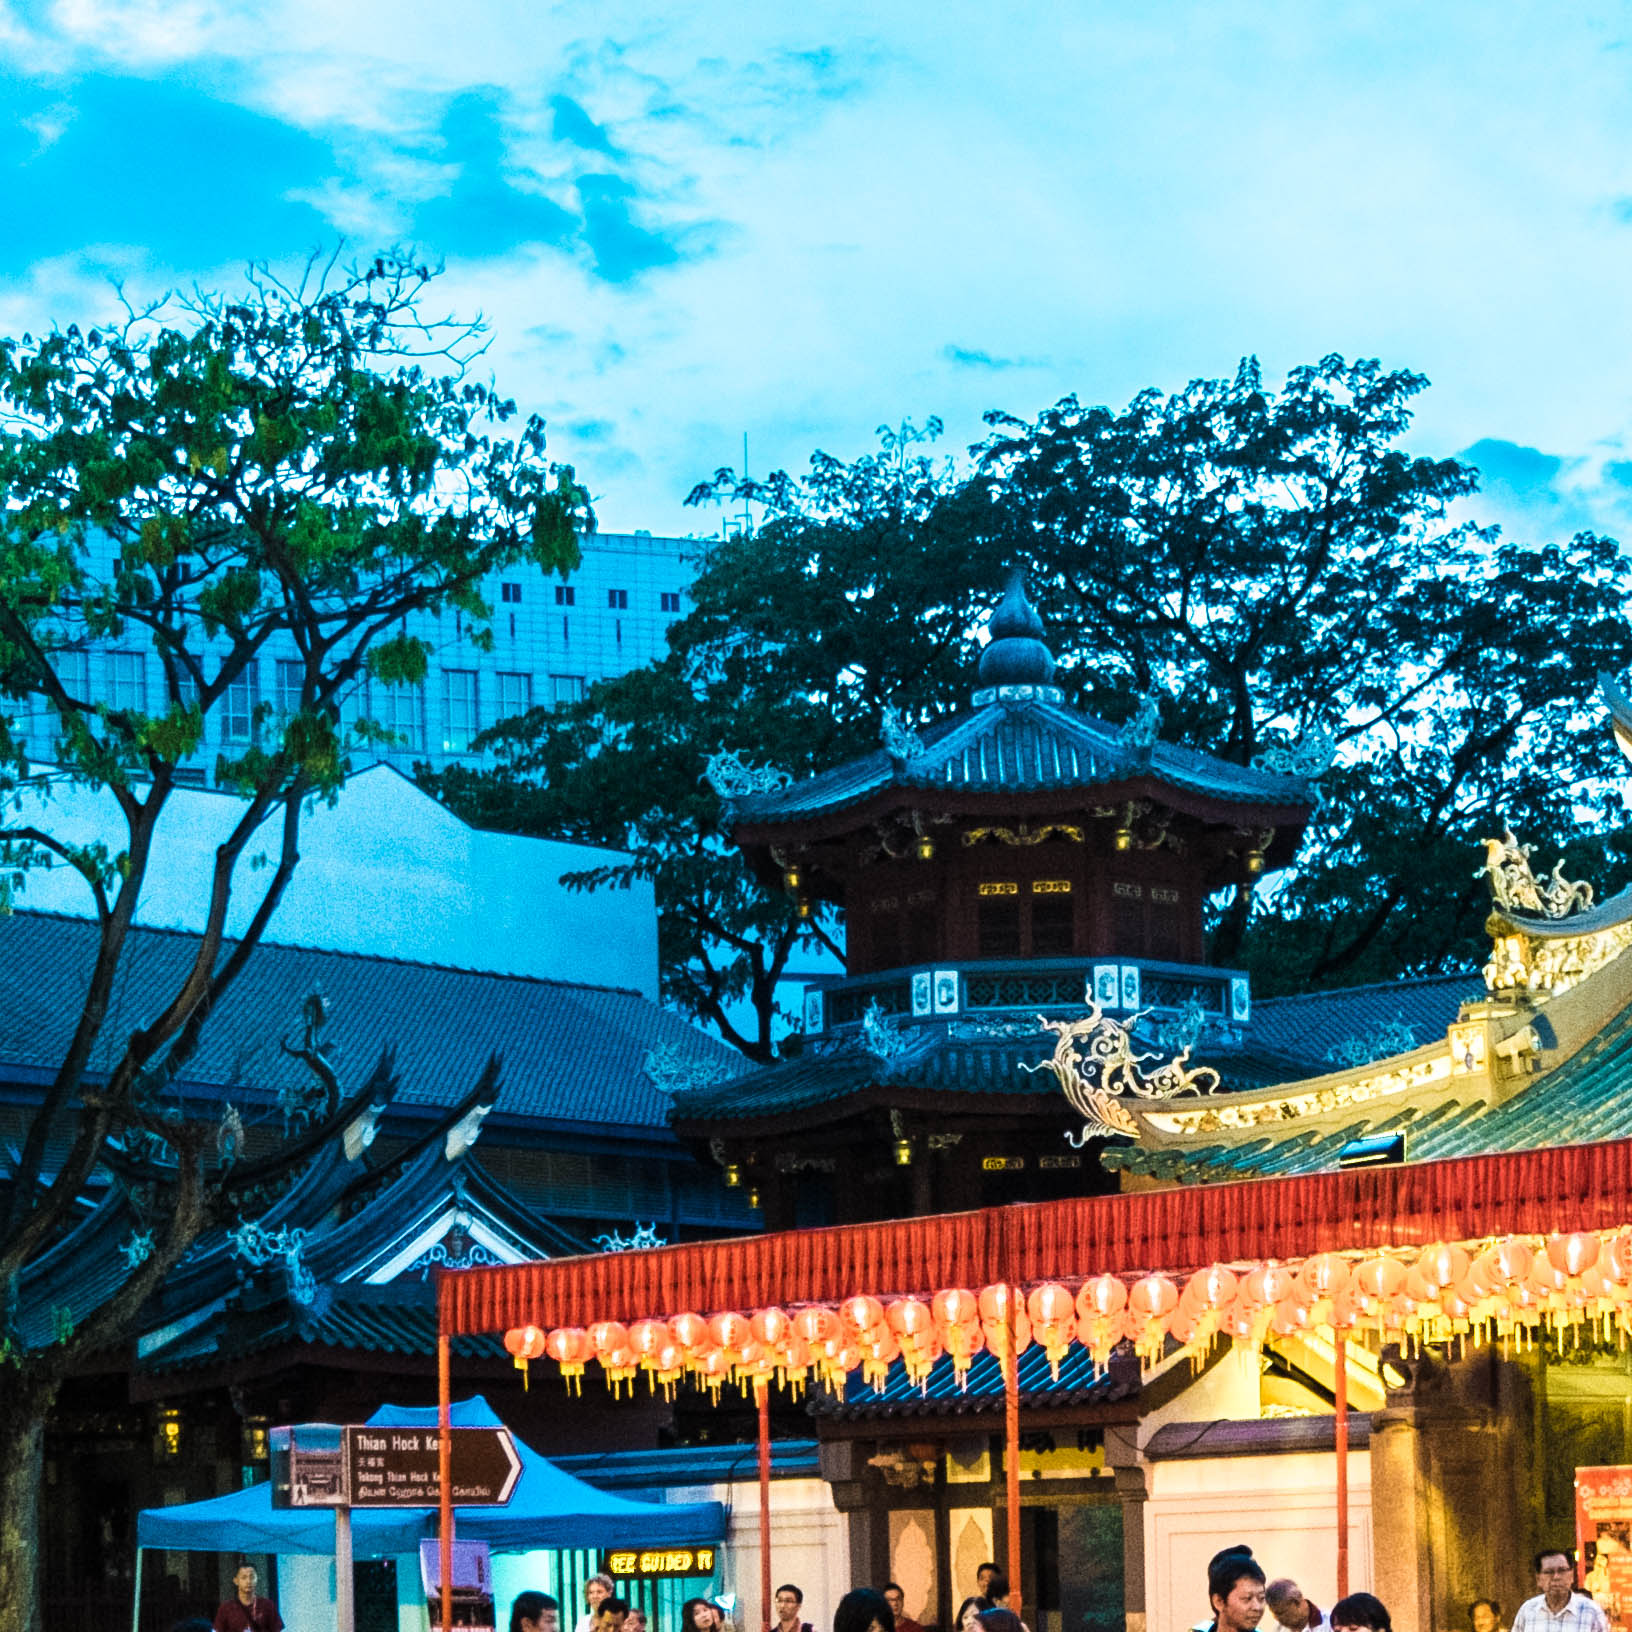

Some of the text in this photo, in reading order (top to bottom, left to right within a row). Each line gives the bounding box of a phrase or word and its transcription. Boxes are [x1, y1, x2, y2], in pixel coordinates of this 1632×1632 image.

[357, 1435, 386, 1450] Thian
[392, 1435, 419, 1450] Hock
[387, 1472, 406, 1482] Thian
[410, 1472, 428, 1482] Hock
[639, 1551, 693, 1572] GUIDED
